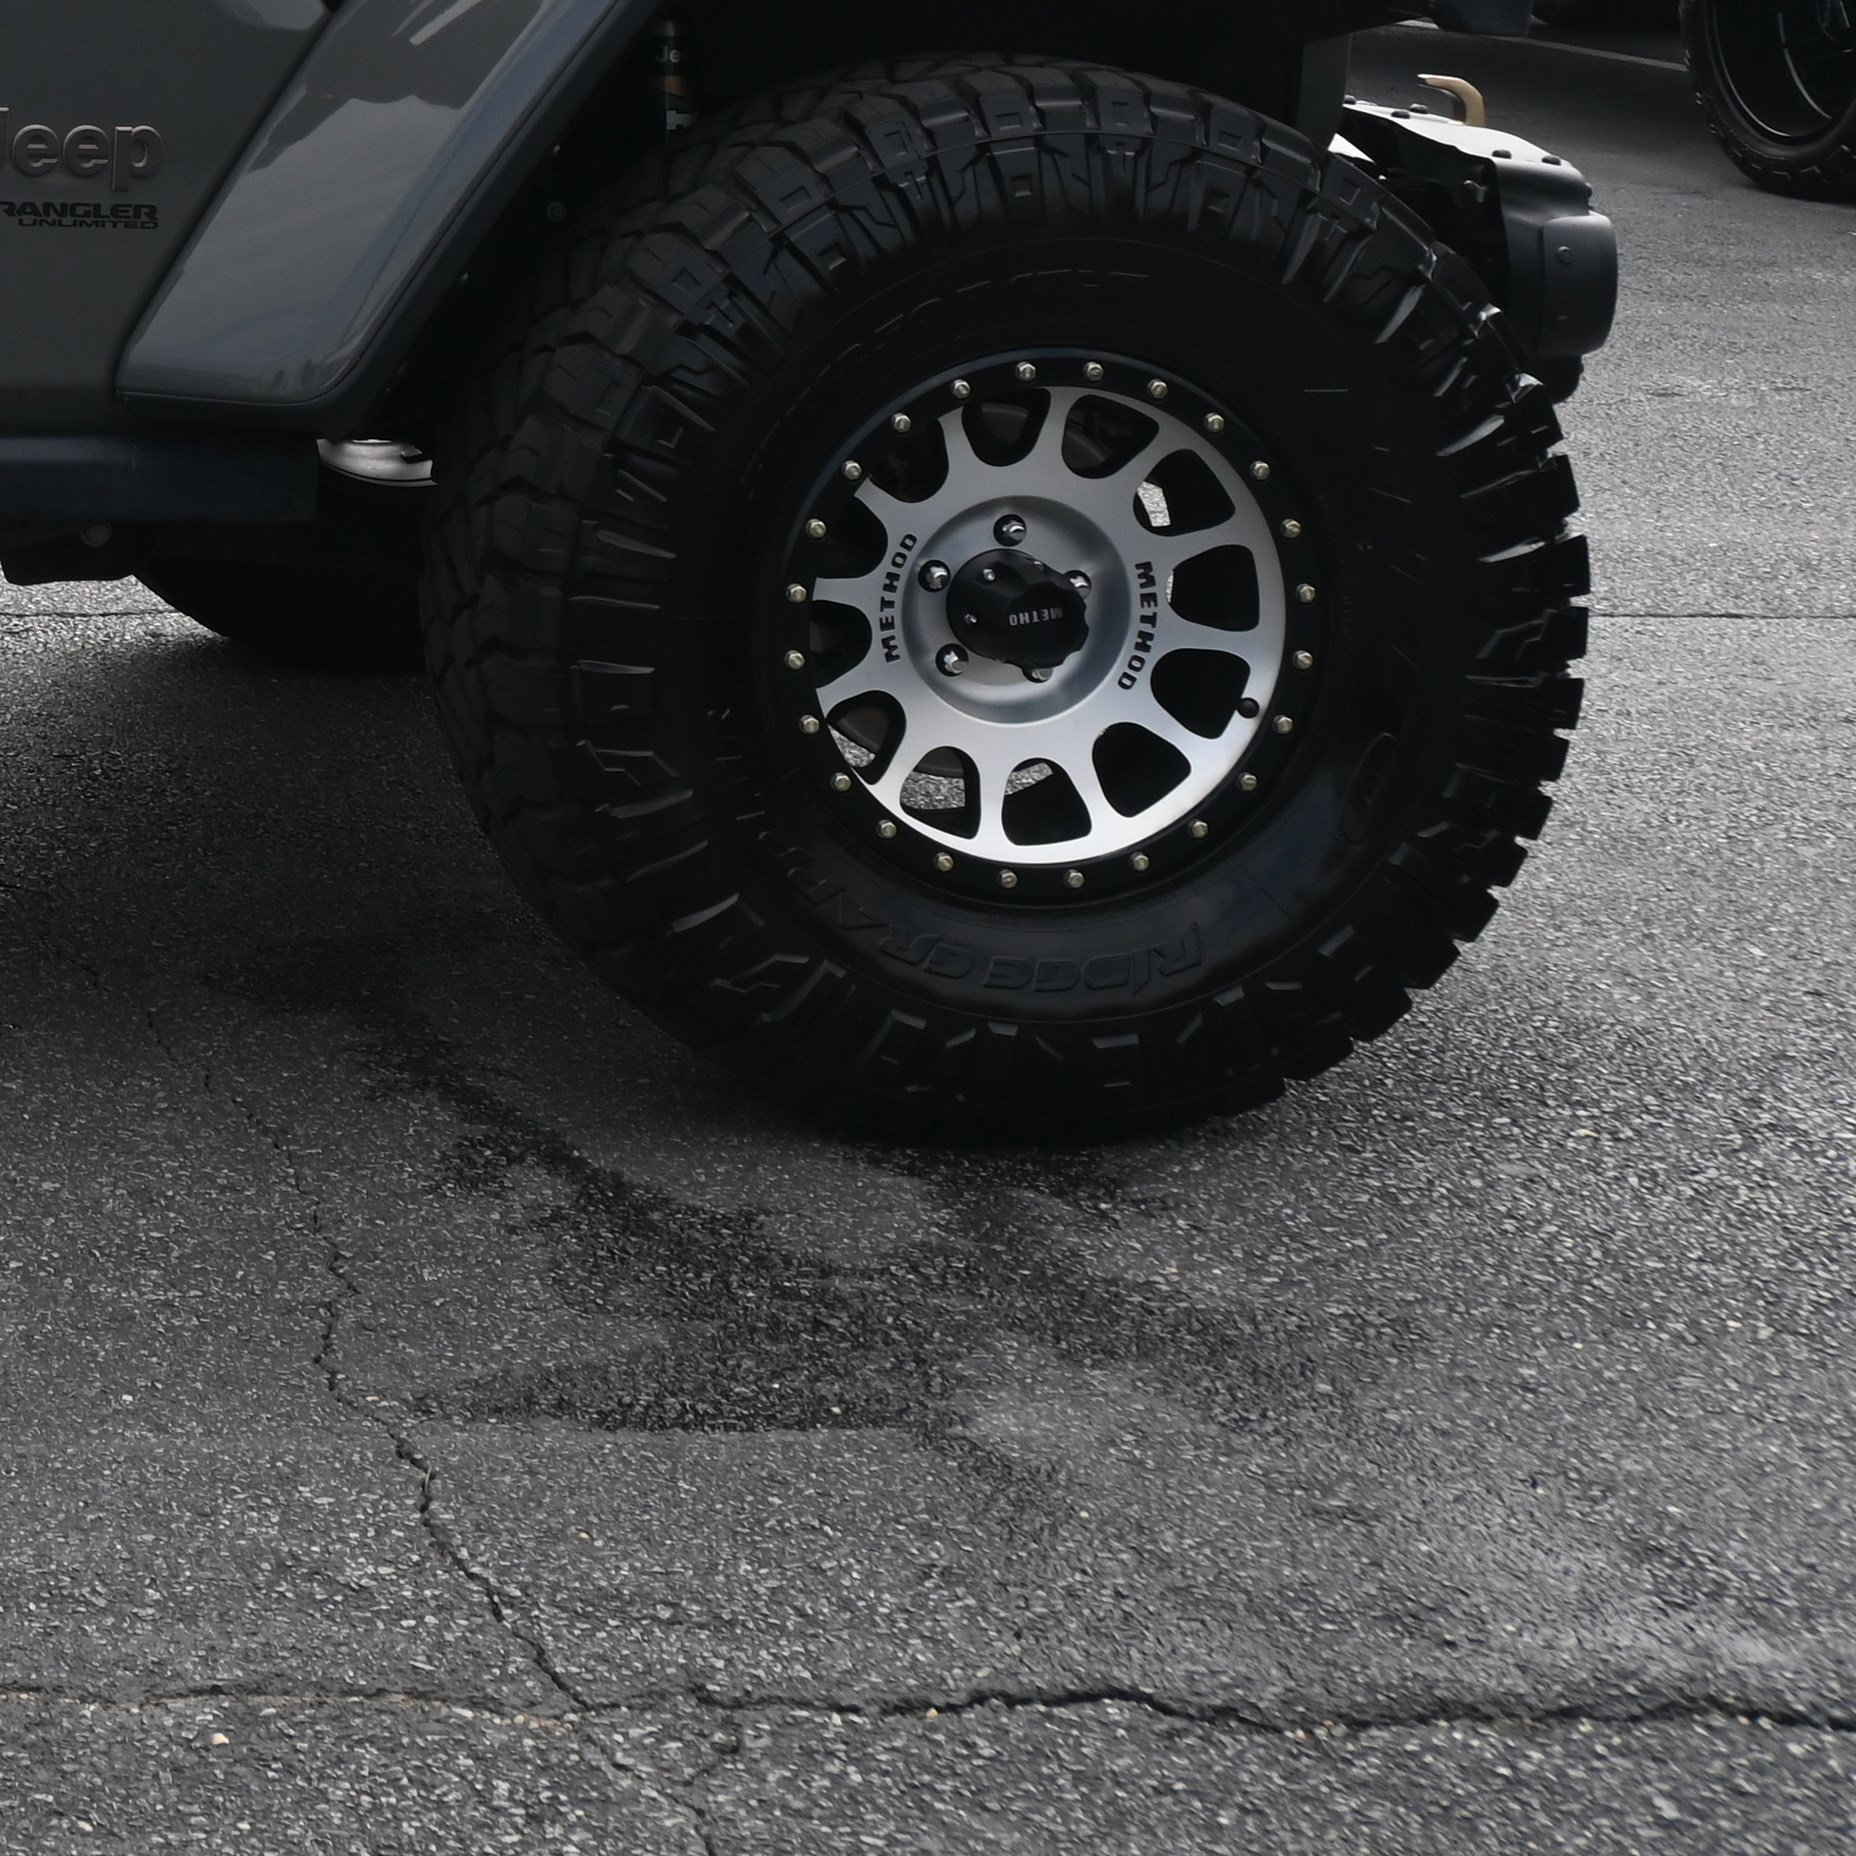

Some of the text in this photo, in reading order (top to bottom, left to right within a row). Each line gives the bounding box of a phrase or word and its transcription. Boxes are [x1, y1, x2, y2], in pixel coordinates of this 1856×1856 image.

[18, 218, 159, 230] UNLIMITED
[878, 533, 918, 664] METHOD
[1118, 561, 1159, 691] METHOD
